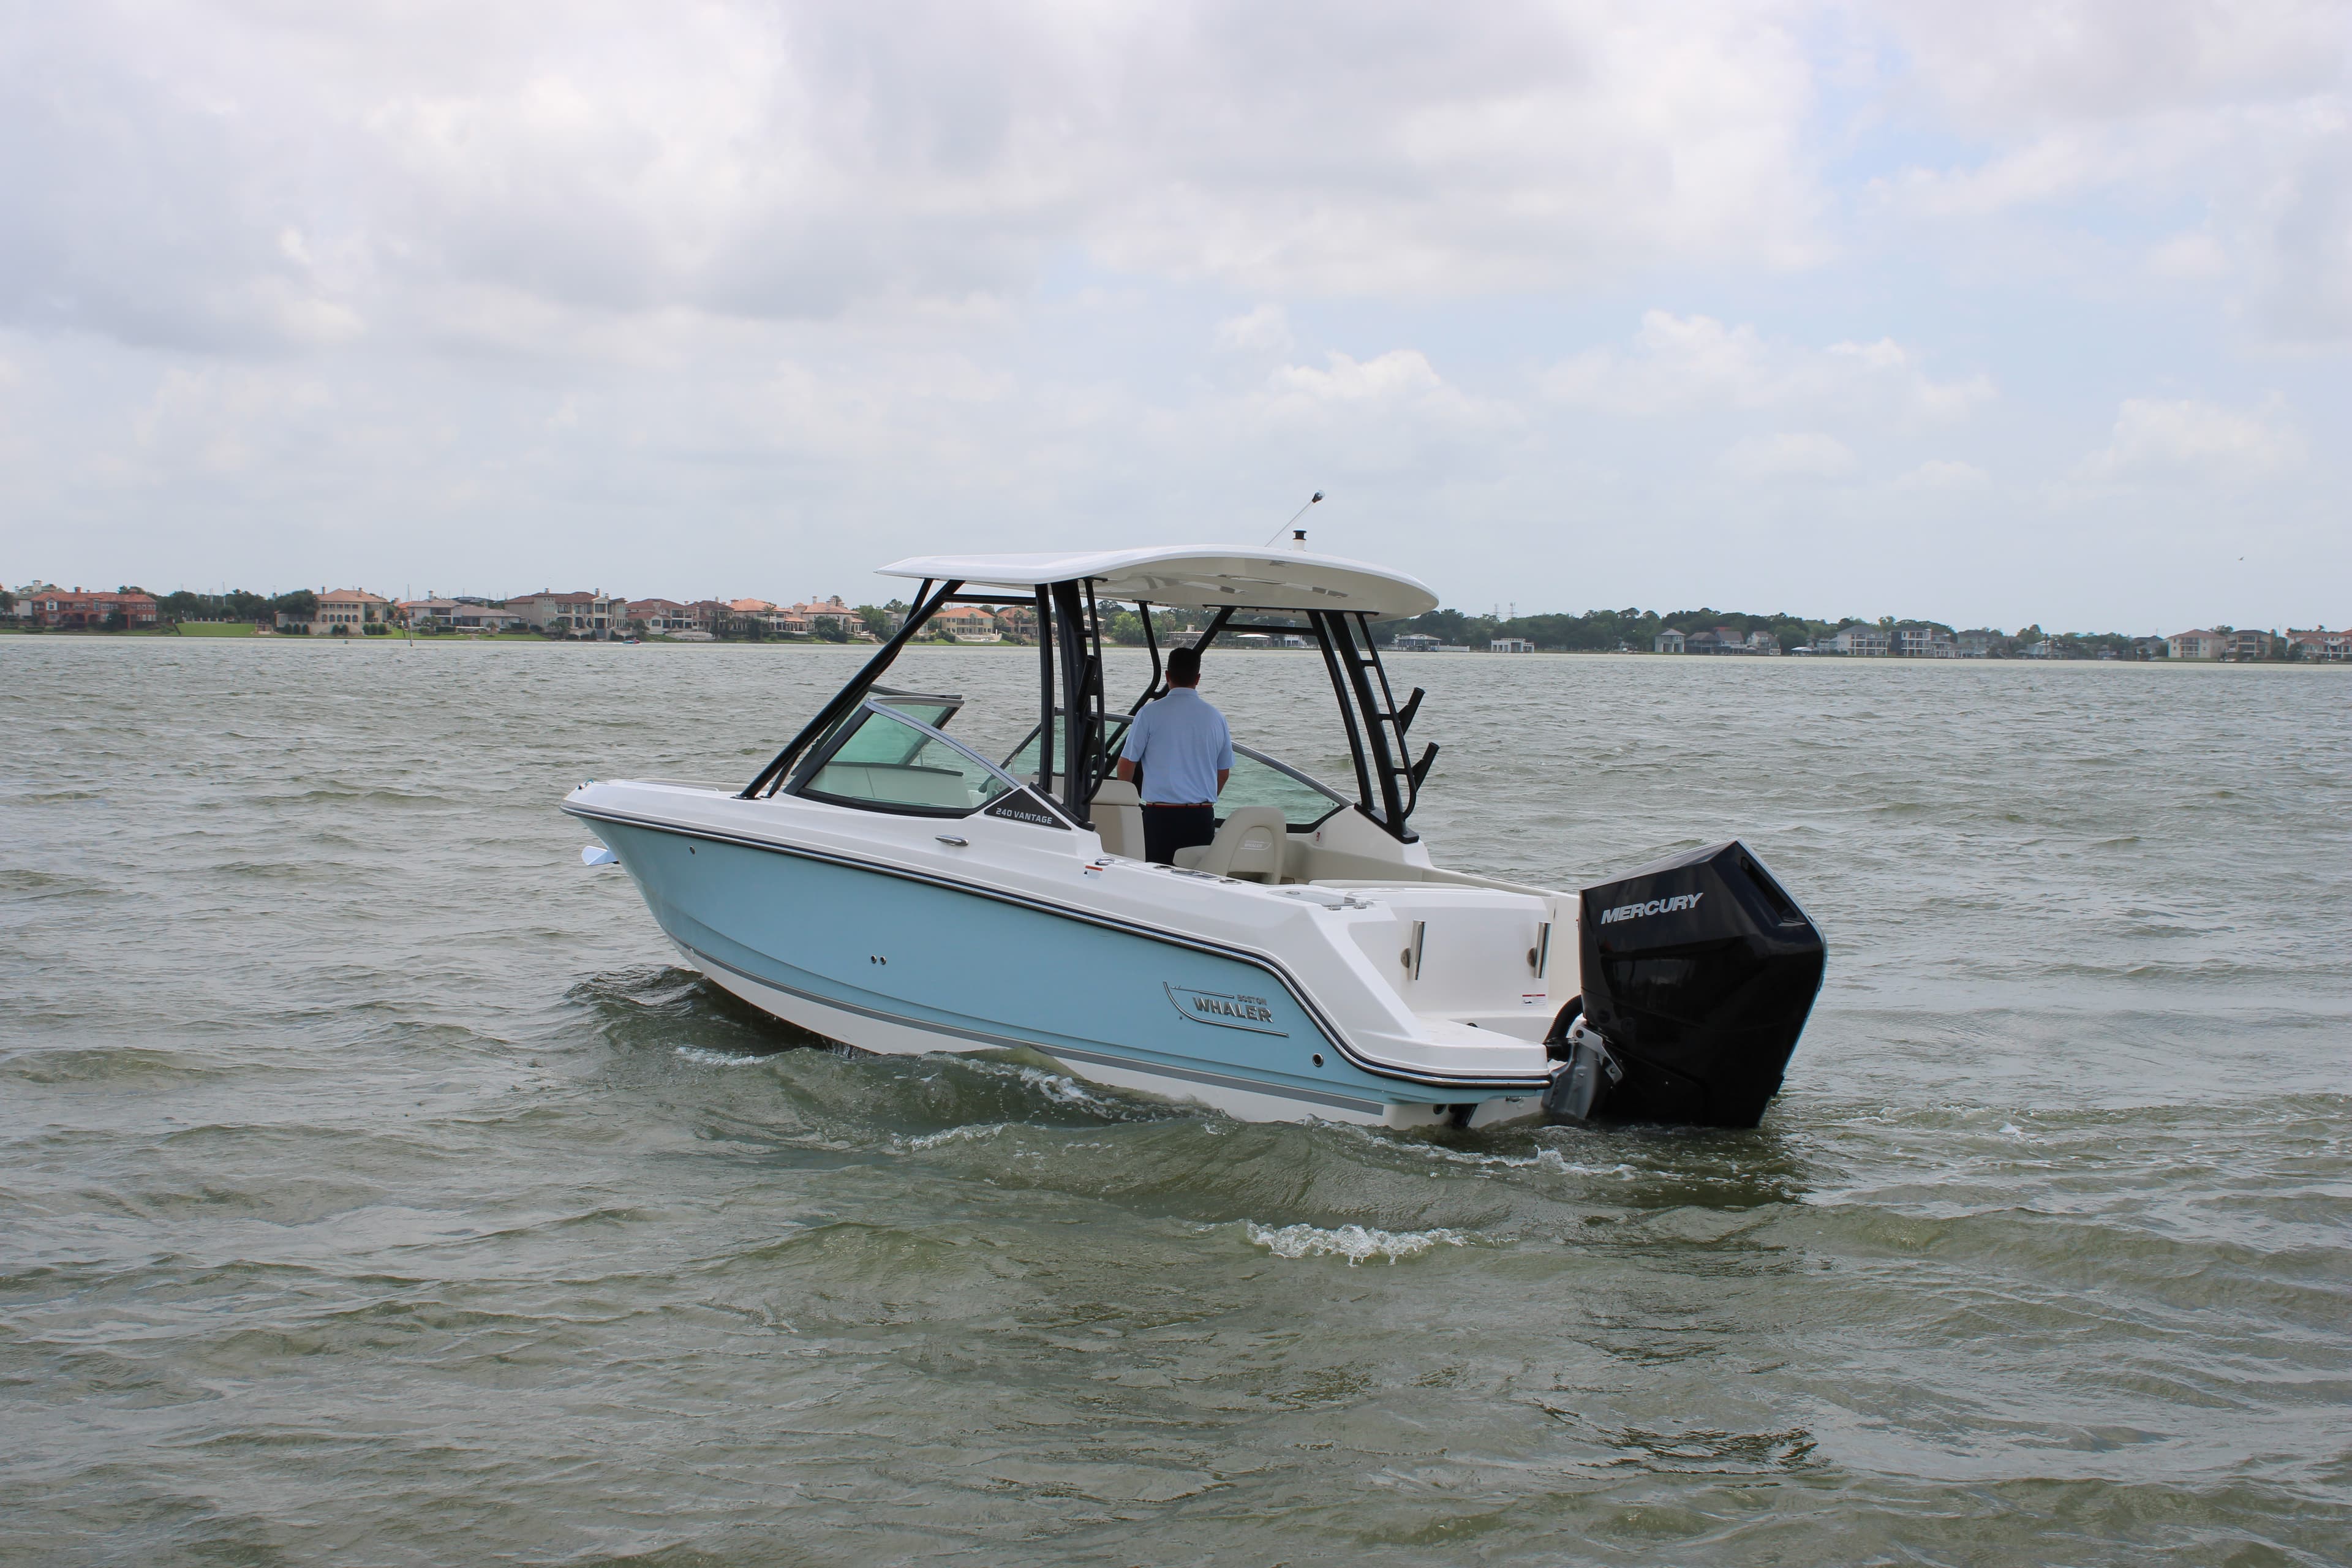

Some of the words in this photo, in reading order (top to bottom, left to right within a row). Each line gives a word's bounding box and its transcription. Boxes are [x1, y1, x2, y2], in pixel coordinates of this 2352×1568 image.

[996, 808, 1012, 816] 240
[1014, 811, 1052, 824] VANTAGE
[1601, 892, 1703, 924] MERCURY
[1193, 997, 1274, 1023] WHALER
[1237, 995, 1267, 1005] BOSTON
